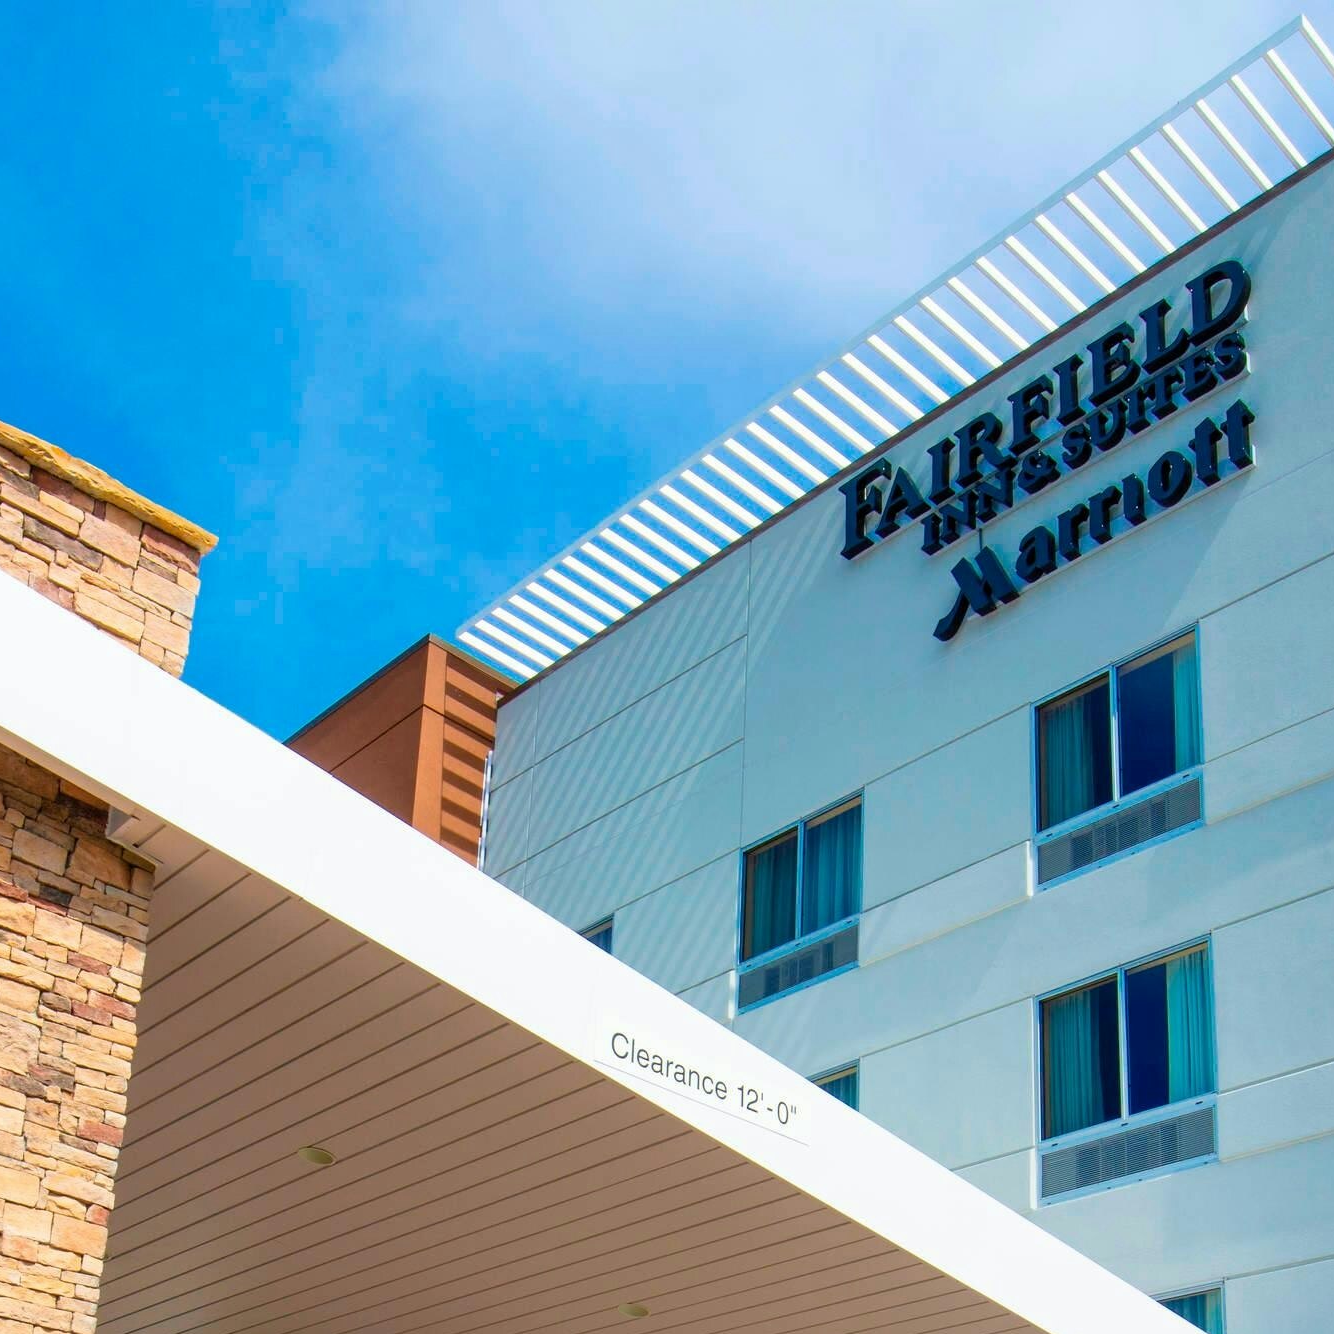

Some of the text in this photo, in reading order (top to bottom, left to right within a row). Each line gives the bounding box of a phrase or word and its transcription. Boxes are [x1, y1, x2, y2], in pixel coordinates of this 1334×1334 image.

[839, 259, 1252, 560] FAIRFIELD
[921, 331, 1247, 556] INN & SUITES
[933, 399, 1256, 641] Marriott
[611, 1032, 728, 1100] Clearance
